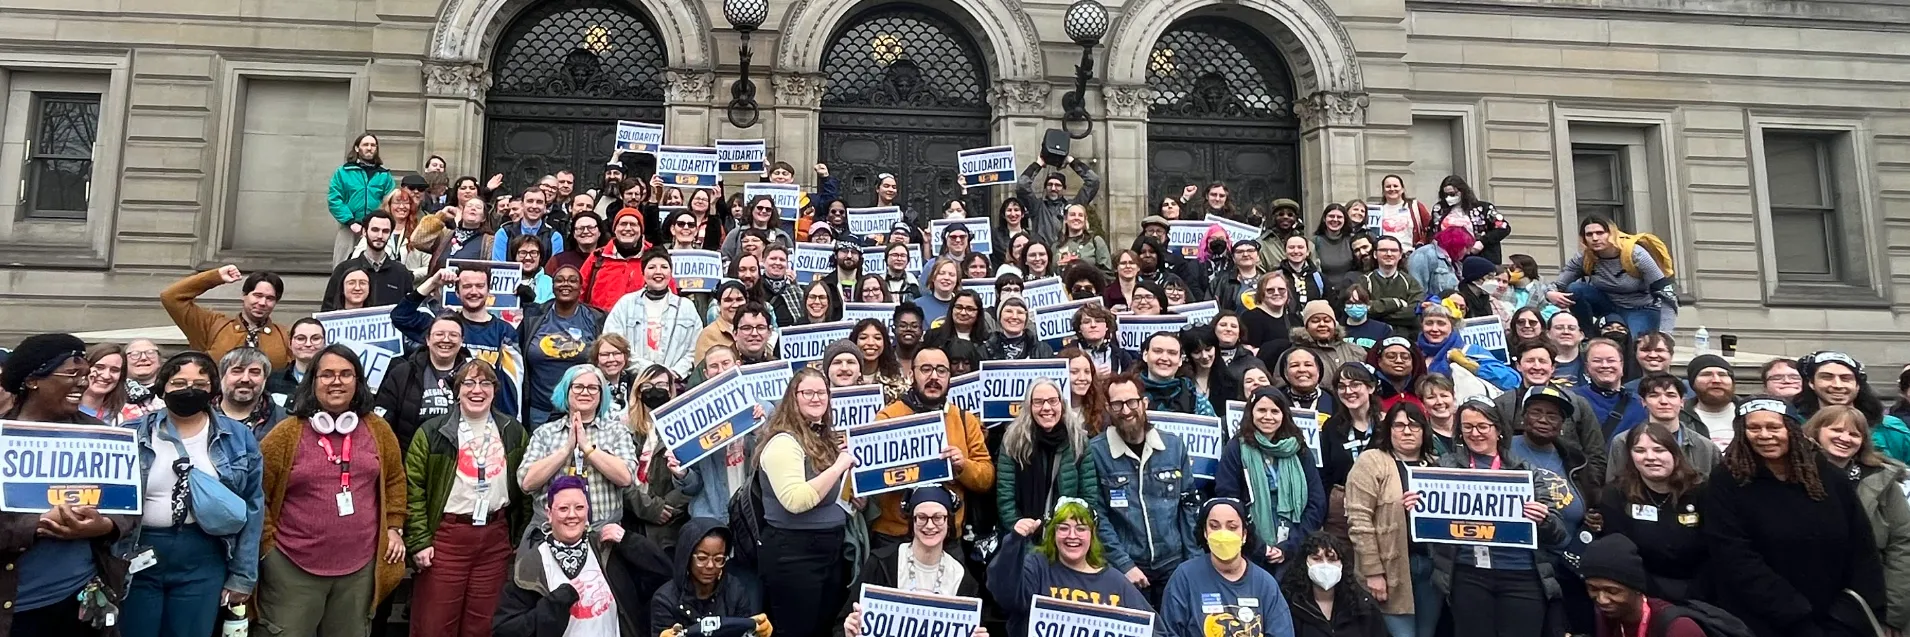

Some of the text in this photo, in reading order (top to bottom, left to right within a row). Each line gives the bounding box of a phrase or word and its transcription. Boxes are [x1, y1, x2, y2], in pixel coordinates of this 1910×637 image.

[618, 130, 661, 142] SOLIDARITY
[718, 150, 764, 160] SOLIDARITY
[659, 158, 718, 173] SOLIDARITY
[962, 157, 1013, 174] SOLIDARITY
[674, 262, 720, 276] LIDARITY
[1024, 290, 1062, 309] DARITY
[1040, 318, 1071, 336] SOLID
[1464, 331, 1502, 348] DARITY
[664, 384, 748, 446] SOLIDARITY
[832, 404, 882, 426] DARITY
[56, 441, 130, 451] STEELWORKERS
[854, 432, 944, 468] SOLIDARITY
[2, 449, 136, 480] SOLIDARITY
[884, 468, 920, 486] USW
[48, 488, 102, 506] USW
[1456, 484, 1526, 492] STEELWORKERS
[1415, 490, 1531, 518] SOLIDARITY
[1450, 523, 1496, 540] USW
[868, 602, 972, 621] UNITED STEELWORKERS
[1040, 612, 1144, 634] UNITED STEELWORKERS
